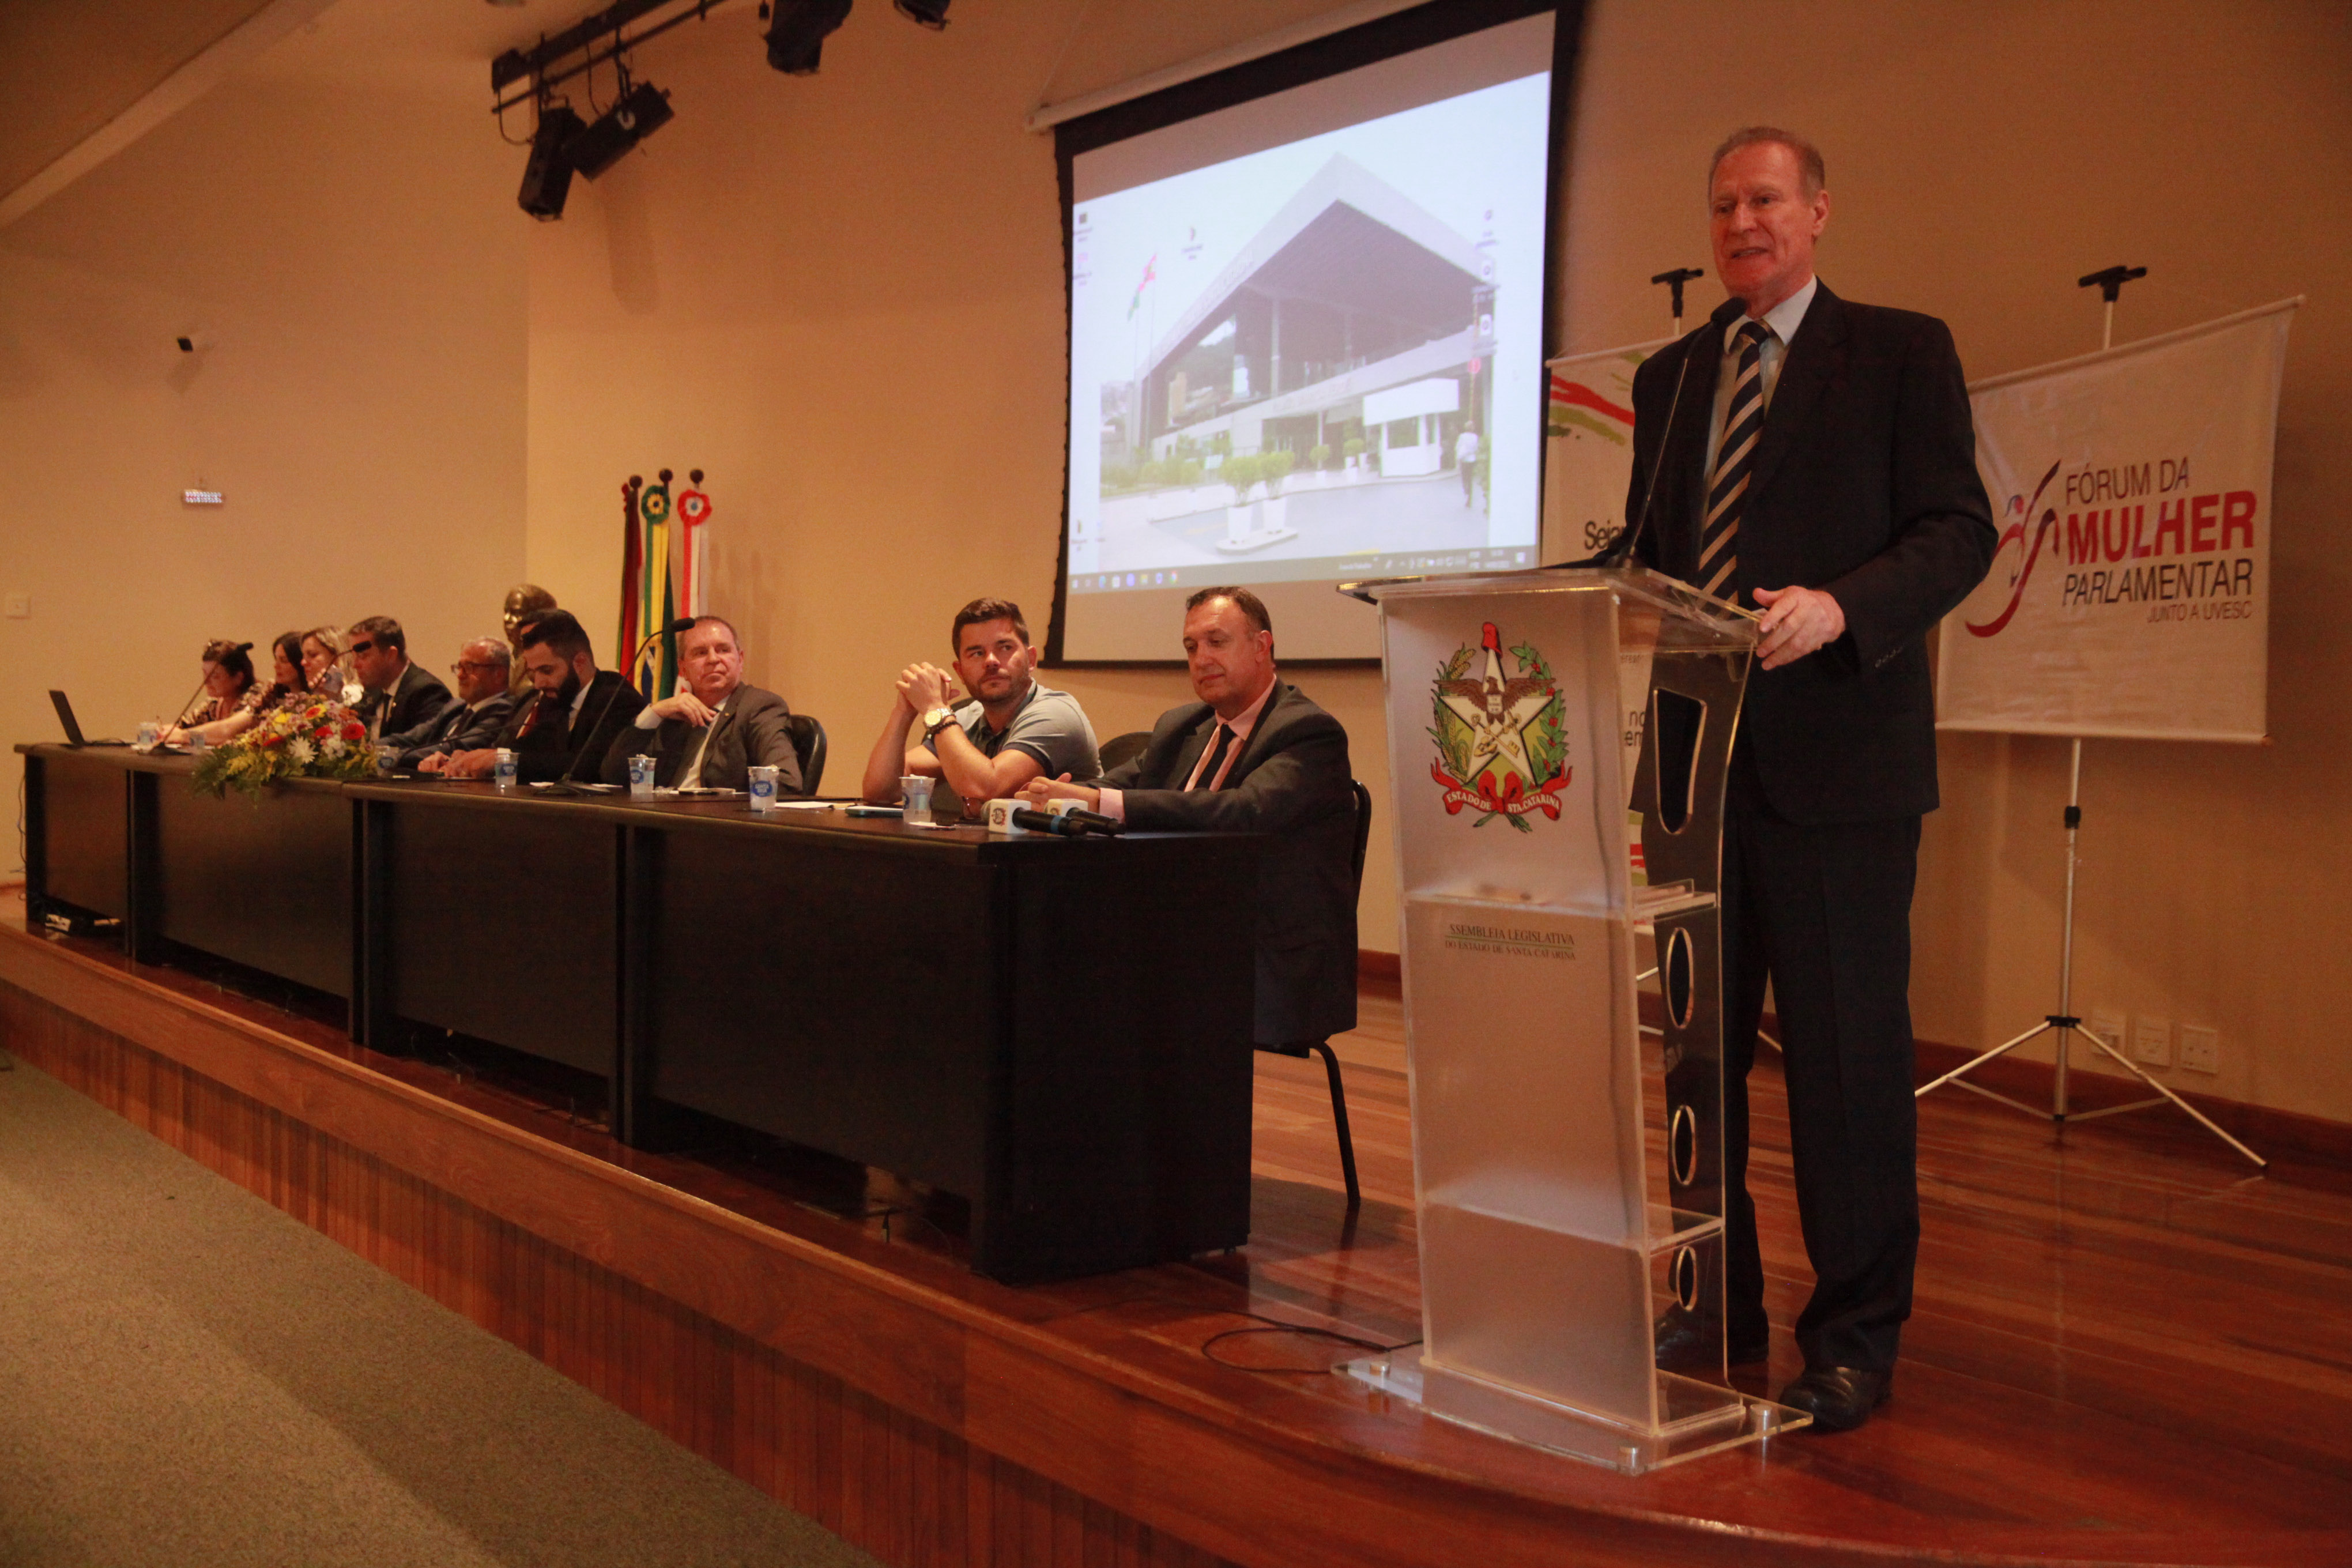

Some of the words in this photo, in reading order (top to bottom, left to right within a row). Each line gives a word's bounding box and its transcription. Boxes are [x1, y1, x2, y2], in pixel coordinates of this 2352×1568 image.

[2066, 462, 2151, 506] FÓRUM
[2159, 457, 2189, 492] DA
[2067, 491, 2256, 566] MULHER
[2062, 558, 2253, 606] PARLAMENTAR
[2191, 605, 2200, 620] A
[2202, 600, 2253, 620] UVESC
[1446, 791, 1480, 806] ESTADO
[1478, 801, 1492, 811] DE
[1508, 929, 1575, 945] LEGISLATIVA
